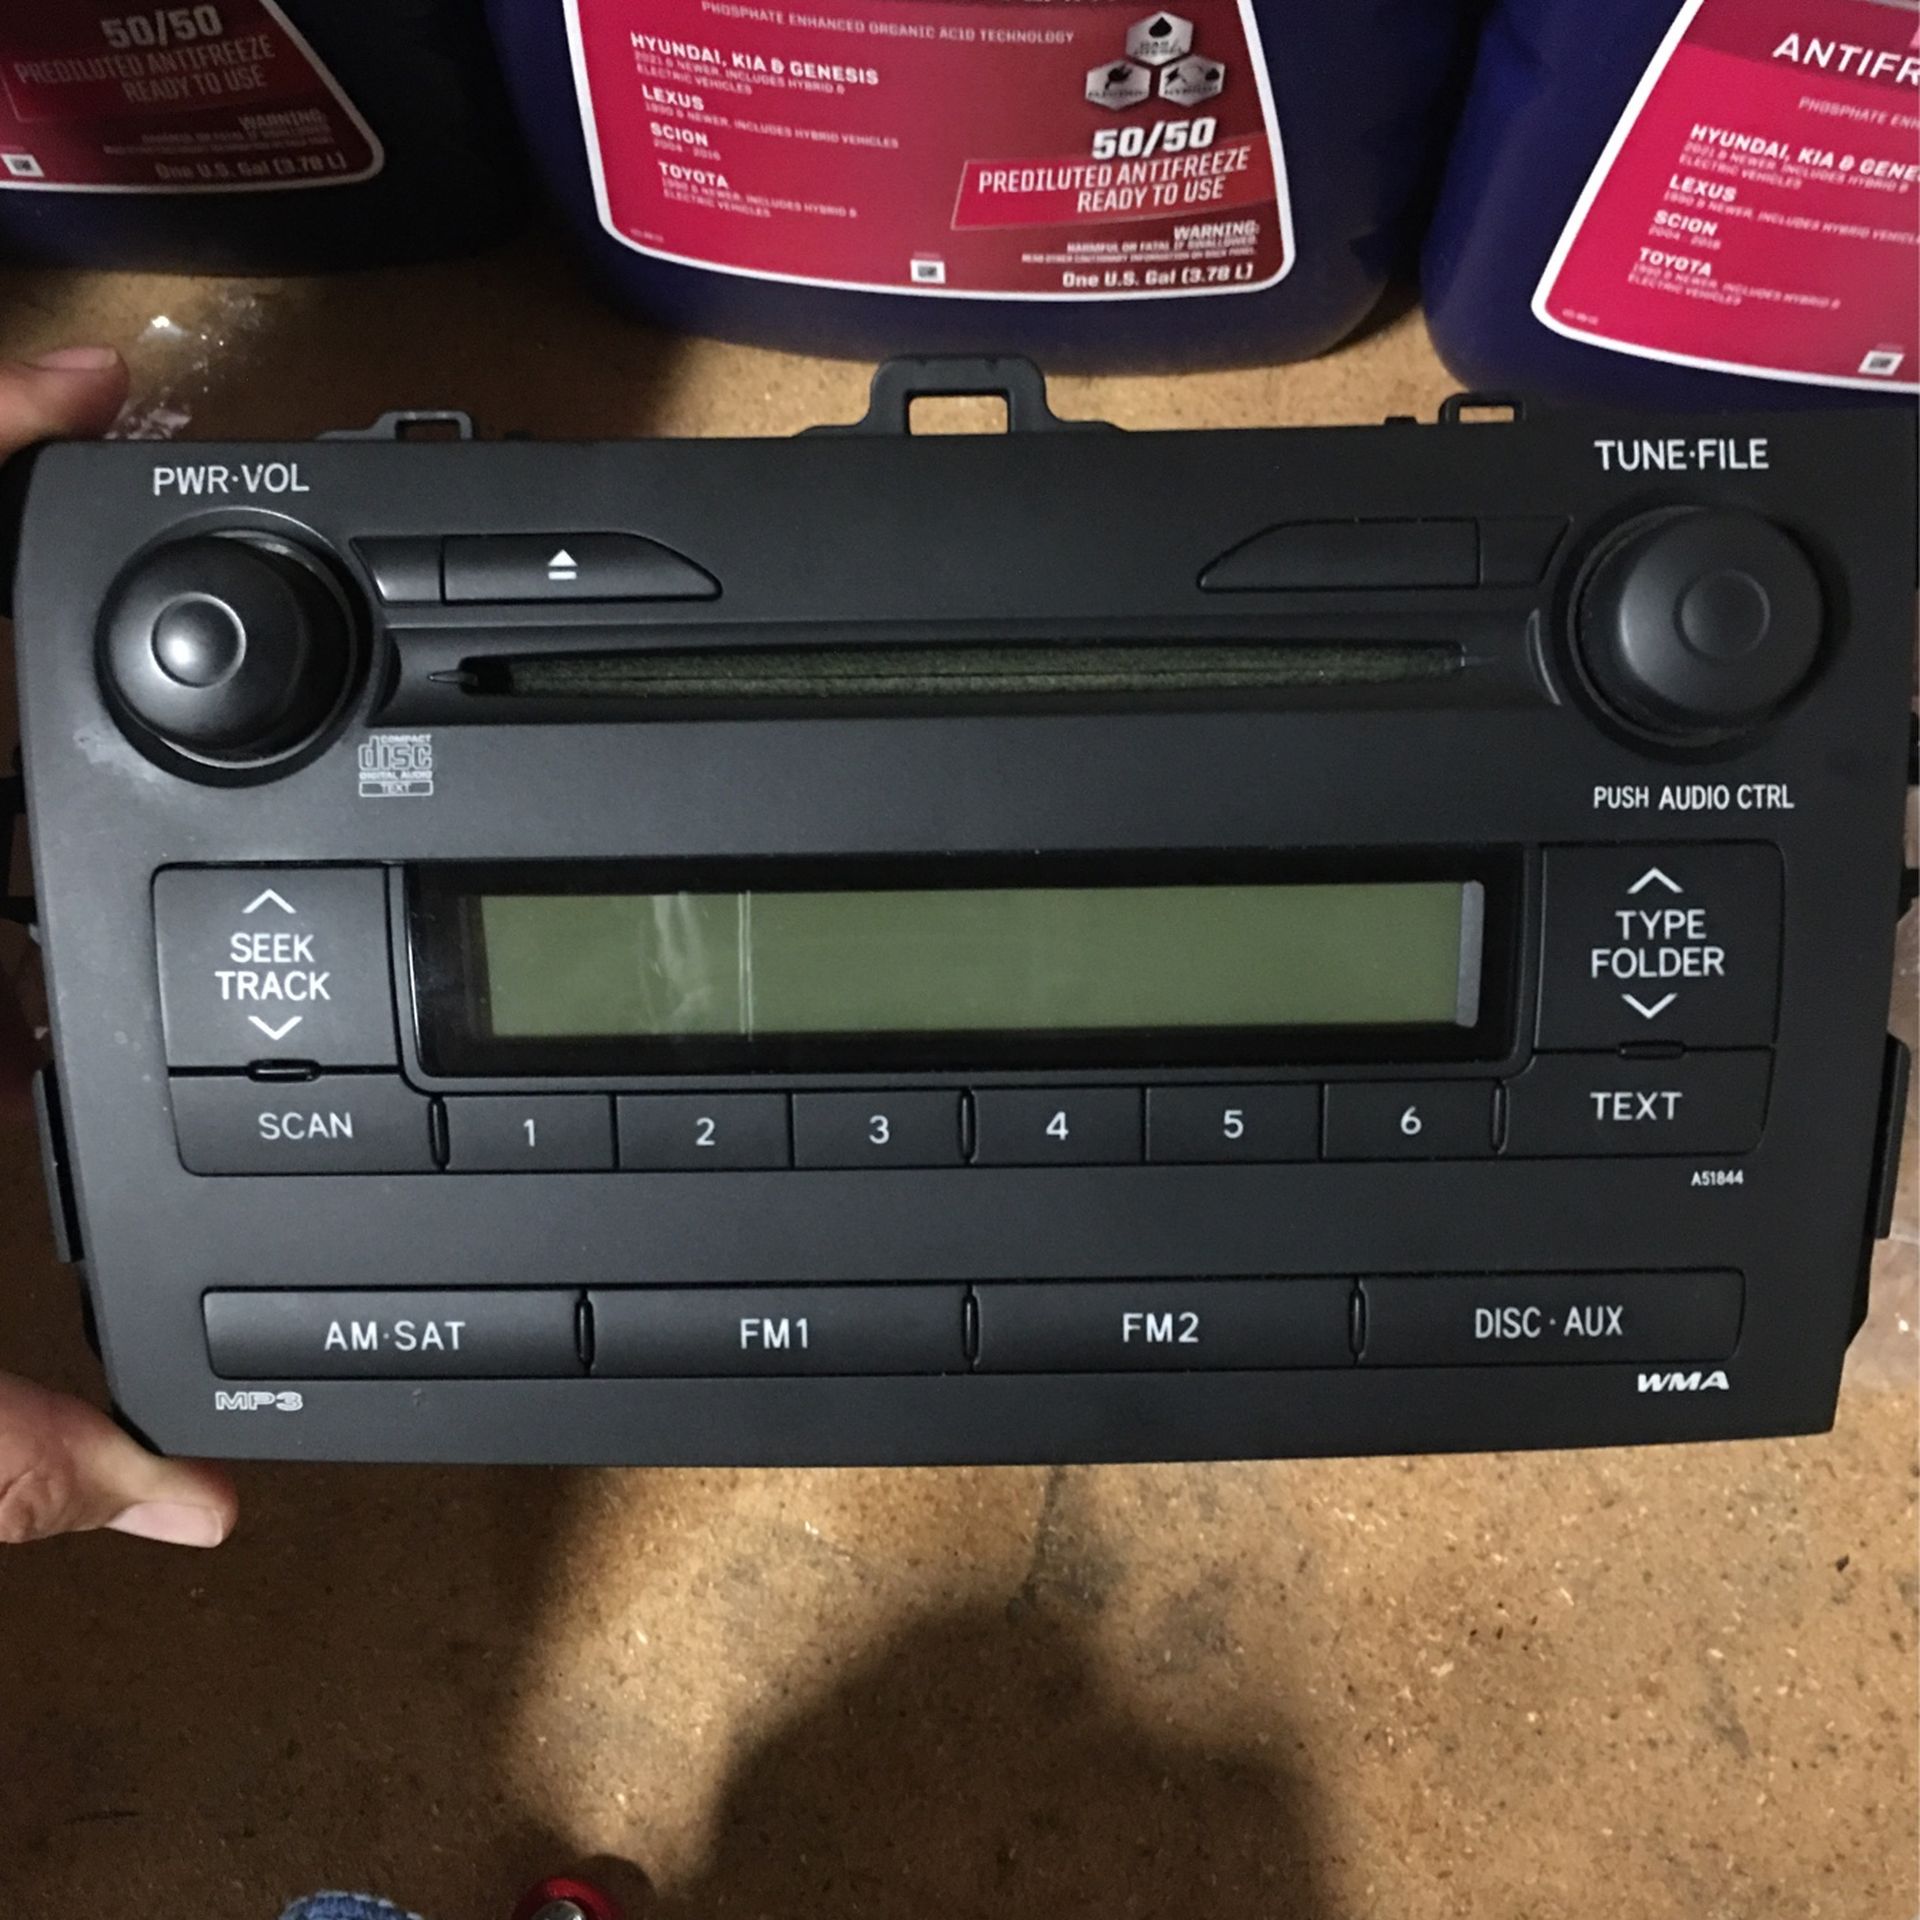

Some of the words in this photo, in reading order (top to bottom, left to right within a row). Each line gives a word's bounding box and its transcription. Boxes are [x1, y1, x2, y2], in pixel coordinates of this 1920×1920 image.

[101, 4, 223, 49] 50/50
[701, 1, 784, 25] PHOSPHATE
[789, 12, 864, 33] ENHANCED
[869, 21, 934, 39] ORGANIC
[939, 26, 975, 41] ACID
[981, 29, 1074, 44] TECHNOLOGY
[13, 54, 144, 84] PREDILUTED
[149, 34, 276, 74] ANTIFREEZE
[630, 31, 727, 68] HYUNDAI,
[732, 51, 767, 73] KIA
[790, 60, 879, 86] GENESIS
[121, 75, 192, 104] READY
[193, 71, 223, 96] TO
[223, 63, 268, 92] USE
[641, 83, 705, 111] LEXUS
[694, 75, 753, 96] VEHICLES
[788, 77, 834, 94] HYBRID
[1799, 96, 1888, 125] PHOSPHATE
[649, 120, 709, 147] SCION
[795, 128, 840, 144] HYBRID
[841, 133, 899, 149] VEHICLES
[1091, 117, 1217, 160] 50/50
[1690, 122, 1790, 162] HYUNDAI,
[1797, 147, 1834, 169] KIA
[1859, 157, 1920, 181] GENE
[657, 160, 729, 189] TOYOTA
[978, 163, 1112, 194] PREDILUTED
[1117, 145, 1251, 187] ANTIFREEZE
[1077, 187, 1148, 214] READY
[1153, 183, 1178, 207] TO
[1184, 176, 1226, 202] USE
[1668, 173, 1737, 202] LEXUS
[1654, 209, 1718, 236] SCION
[1062, 270, 1099, 288] One
[1104, 270, 1140, 287] U.S.
[1145, 268, 1175, 285] Gal
[1181, 265, 1231, 284] (3.78
[1235, 262, 1254, 280] L)
[1639, 247, 1712, 278] TOYOTA
[1593, 785, 1649, 809] PUSH
[1658, 784, 1730, 811] AUDIO
[1737, 783, 1795, 809] CTRL
[1615, 908, 1707, 941] TYPE
[229, 932, 315, 964] SEEK
[1590, 946, 1726, 980] FOLDER
[214, 970, 331, 1002] TRACK
[1400, 1106, 1423, 1136] 6
[1590, 1091, 1683, 1121] TEXT
[258, 1111, 354, 1140] SCAN
[523, 1118, 536, 1148] 1
[695, 1117, 716, 1147] 2
[868, 1115, 891, 1145] 3
[1045, 1110, 1070, 1141] 4
[1223, 1109, 1245, 1139] 5
[1690, 1168, 1745, 1187] A51844
[740, 1318, 810, 1350] FM1
[1122, 1311, 1200, 1345] FM2
[1636, 1370, 1730, 1393] WMA
[215, 1391, 304, 1412] MP3
